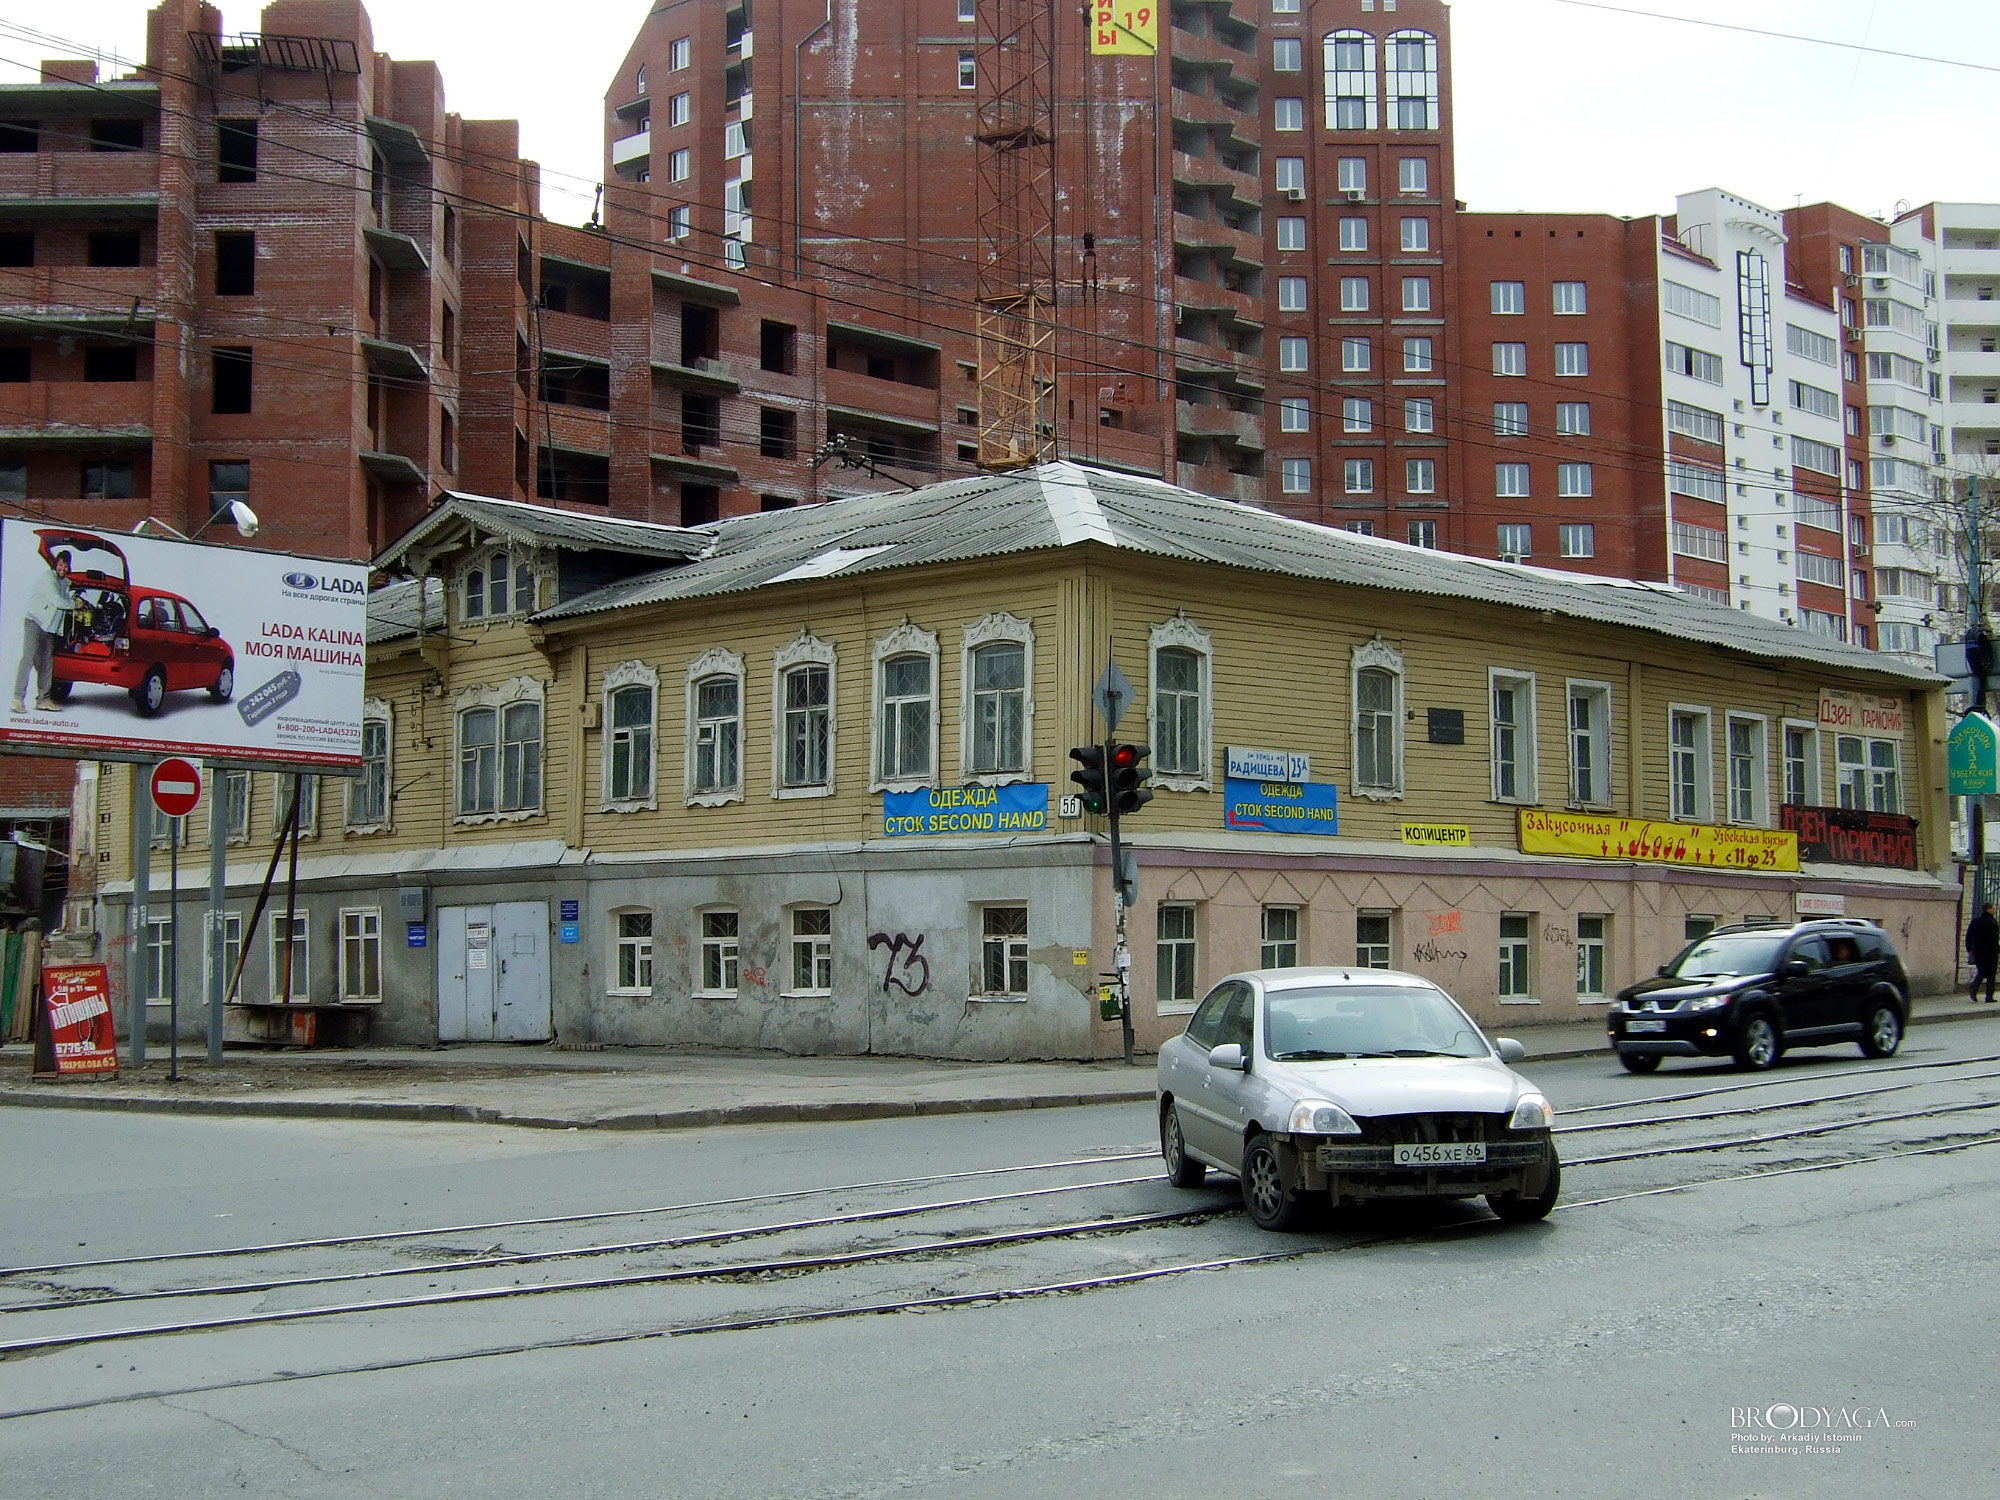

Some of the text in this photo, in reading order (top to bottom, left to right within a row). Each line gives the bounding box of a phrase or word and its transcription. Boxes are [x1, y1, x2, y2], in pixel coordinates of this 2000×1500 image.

[1125, 8, 1150, 30] 19
[321, 576, 365, 595] LADA
[281, 589, 365, 606] На всех дорогах страны
[262, 622, 364, 646] LADA KALINA
[245, 641, 363, 667] МОЯ МАШИНА
[9, 716, 79, 728] www.lada-auto.ru
[1821, 699, 1852, 726] Дзен
[1862, 708, 1902, 731] ГАРМОНИЯ
[1230, 761, 1285, 777] РАДИЩЕВА
[929, 787, 998, 810] ОДЕЖДА
[1260, 783, 1303, 799] ОДЕЖДА
[1063, 799, 1076, 814] 56
[1235, 803, 1334, 821] СТОК SECOND HAND
[885, 810, 1044, 834] СТОК SECOND HAND
[1526, 812, 1611, 837] Закусочная
[1405, 826, 1466, 844] КОПИЦЕНТР
[1713, 828, 1788, 849] Узбекская кухня
[1735, 847, 1745, 864] 11
[1762, 849, 1776, 866] 23
[1829, 825, 1914, 869] ГАРМОНИЯ
[51, 993, 109, 1030] АВТОШИНЫ
[102, 1057, 116, 1067] 63
[1466, 1144, 1481, 1156] 66
